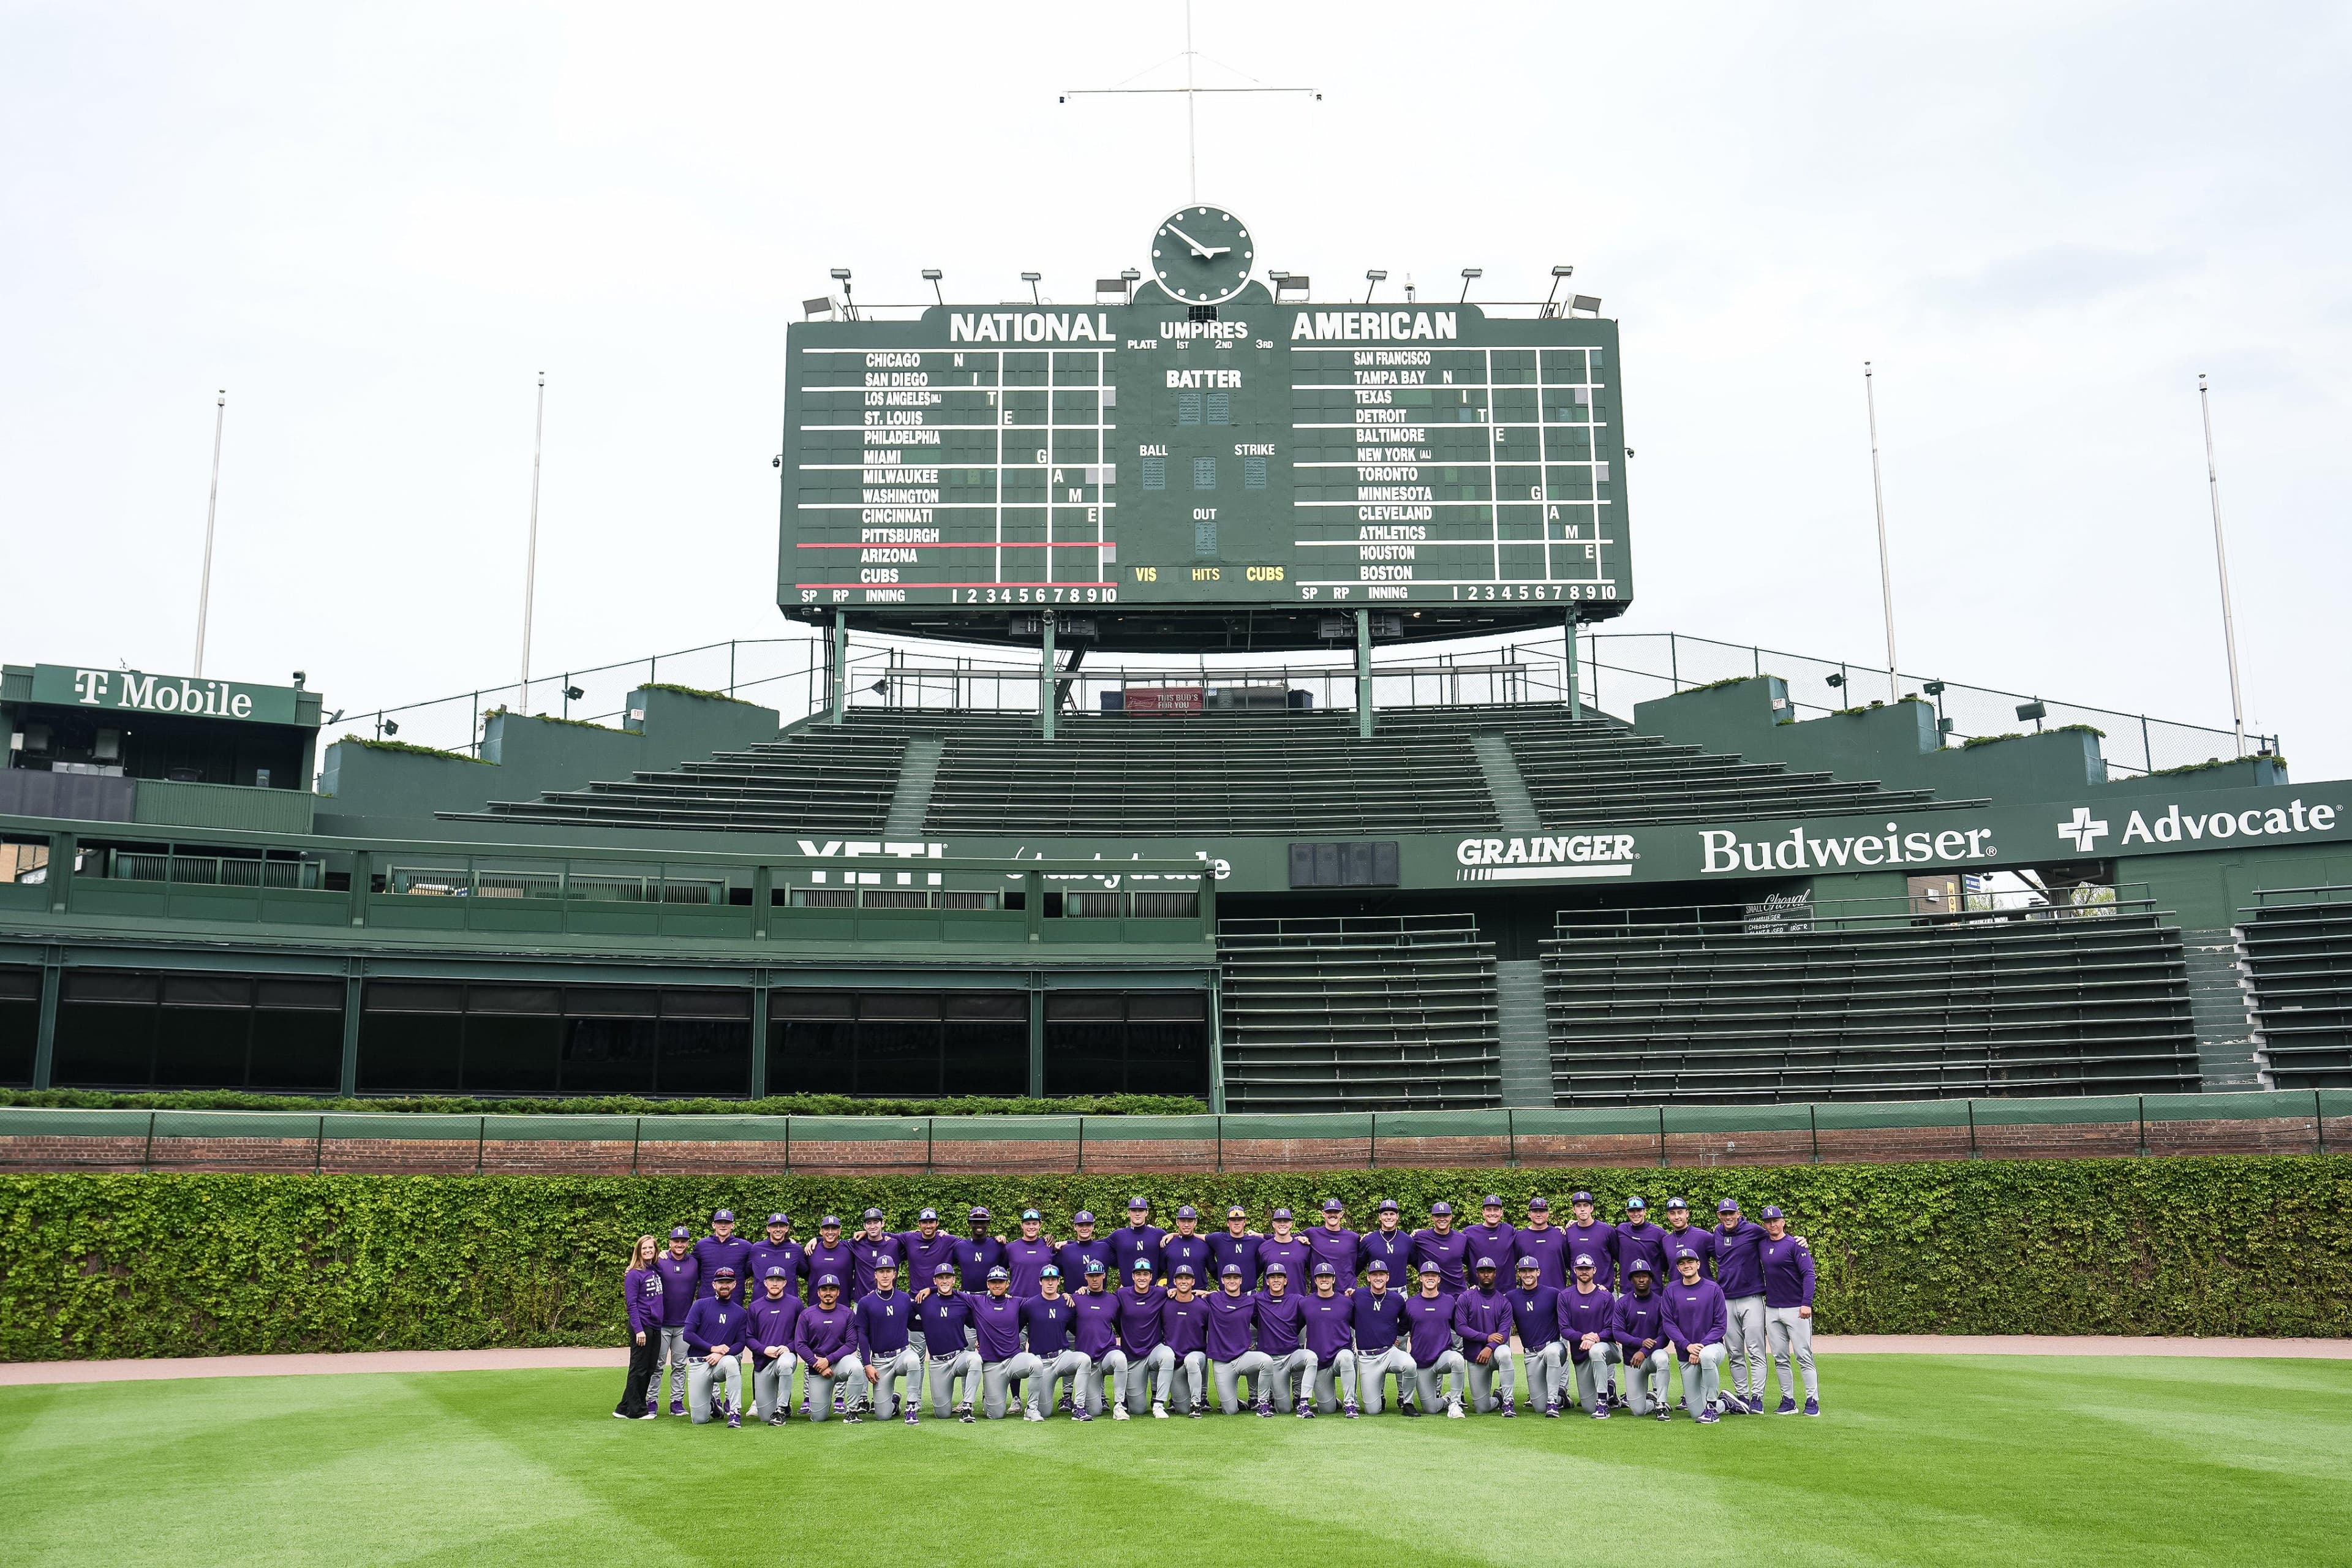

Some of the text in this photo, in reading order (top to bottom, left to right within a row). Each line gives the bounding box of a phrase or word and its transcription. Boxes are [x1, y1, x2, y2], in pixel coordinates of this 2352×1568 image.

[950, 312, 1117, 342] NATIONAL
[1160, 322, 1248, 339] UMPIRES
[1291, 311, 1457, 340] AMERICAN
[1127, 339, 1158, 349] PLATE
[865, 353, 921, 368] CHICAGO
[954, 353, 963, 367] N
[1354, 351, 1431, 366] SAN FRANCISCO
[865, 372, 928, 387] SAN DIEGO
[973, 372, 978, 386] I
[1166, 369, 1242, 388] BATTER
[1354, 370, 1427, 385] TAMPA BAY
[1443, 370, 1453, 384] N
[865, 391, 884, 406] LOS
[987, 391, 996, 405] T
[1354, 390, 1392, 404] TEXAS
[1462, 390, 1467, 404] I
[864, 410, 924, 426] ST. LOUIS
[1004, 410, 1013, 424] E
[1355, 409, 1407, 423] DETROIT
[1477, 409, 1487, 423] T
[864, 430, 941, 445] PHILADELPHIA
[1356, 428, 1425, 443] BALTIMORE
[1496, 428, 1505, 442] E
[1036, 449, 1047, 464] G
[1139, 444, 1169, 456] BALL
[1234, 443, 1275, 456] STRIKE
[1357, 448, 1382, 462] NEW
[1384, 447, 1417, 462] YORK
[864, 450, 901, 464] MIAMI
[863, 469, 938, 484] MILWAUKEE
[1053, 469, 1064, 483] A
[1357, 467, 1419, 481] TORONTO
[862, 488, 939, 503] WASHINGTON
[1068, 488, 1082, 502] M
[1358, 486, 1433, 501] MINNESOTA
[1531, 486, 1541, 500] G
[862, 508, 933, 524] CINCINNATI
[1088, 508, 1097, 522] E
[1193, 508, 1217, 520] OUT
[1359, 506, 1433, 521] CLEVELAND
[1549, 505, 1560, 519] A
[861, 528, 940, 543] PITTSBURGH
[1359, 526, 1427, 540] ATHLETICS
[1565, 525, 1578, 539] M
[860, 548, 918, 563] ARIZONA
[1360, 545, 1415, 560] HOUSTON
[1585, 545, 1594, 559] E
[861, 568, 899, 584] CUBS
[1135, 567, 1157, 582] VIS
[1192, 568, 1220, 581] HITS
[1246, 566, 1284, 581] CUBS
[1360, 565, 1413, 581] BOSTON
[801, 588, 1117, 603] SP RP INNING 1 2 3 4 5 6 7 8 9 10
[1302, 585, 1616, 600] SP RP INNING 1 2 3 4 5 6 7 8 9 10
[118, 674, 253, 717] Mobile
[2121, 799, 2335, 845] Advocate
[1457, 834, 1635, 865] GRAINGER
[1698, 822, 1994, 873] Budweiser
[1746, 905, 1762, 914] SMALL
[1137, 1241, 1143, 1250] N
[1183, 1248, 1189, 1256] N
[1236, 1244, 1242, 1253] N
[1387, 1244, 1393, 1253] N
[975, 1253, 982, 1261] N
[1083, 1255, 1089, 1264] N
[886, 1306, 893, 1316] N
[941, 1307, 948, 1317] N
[1374, 1301, 1381, 1311] N
[1527, 1302, 1533, 1311] N
[719, 1314, 726, 1324] N
[1049, 1309, 1055, 1318] N
